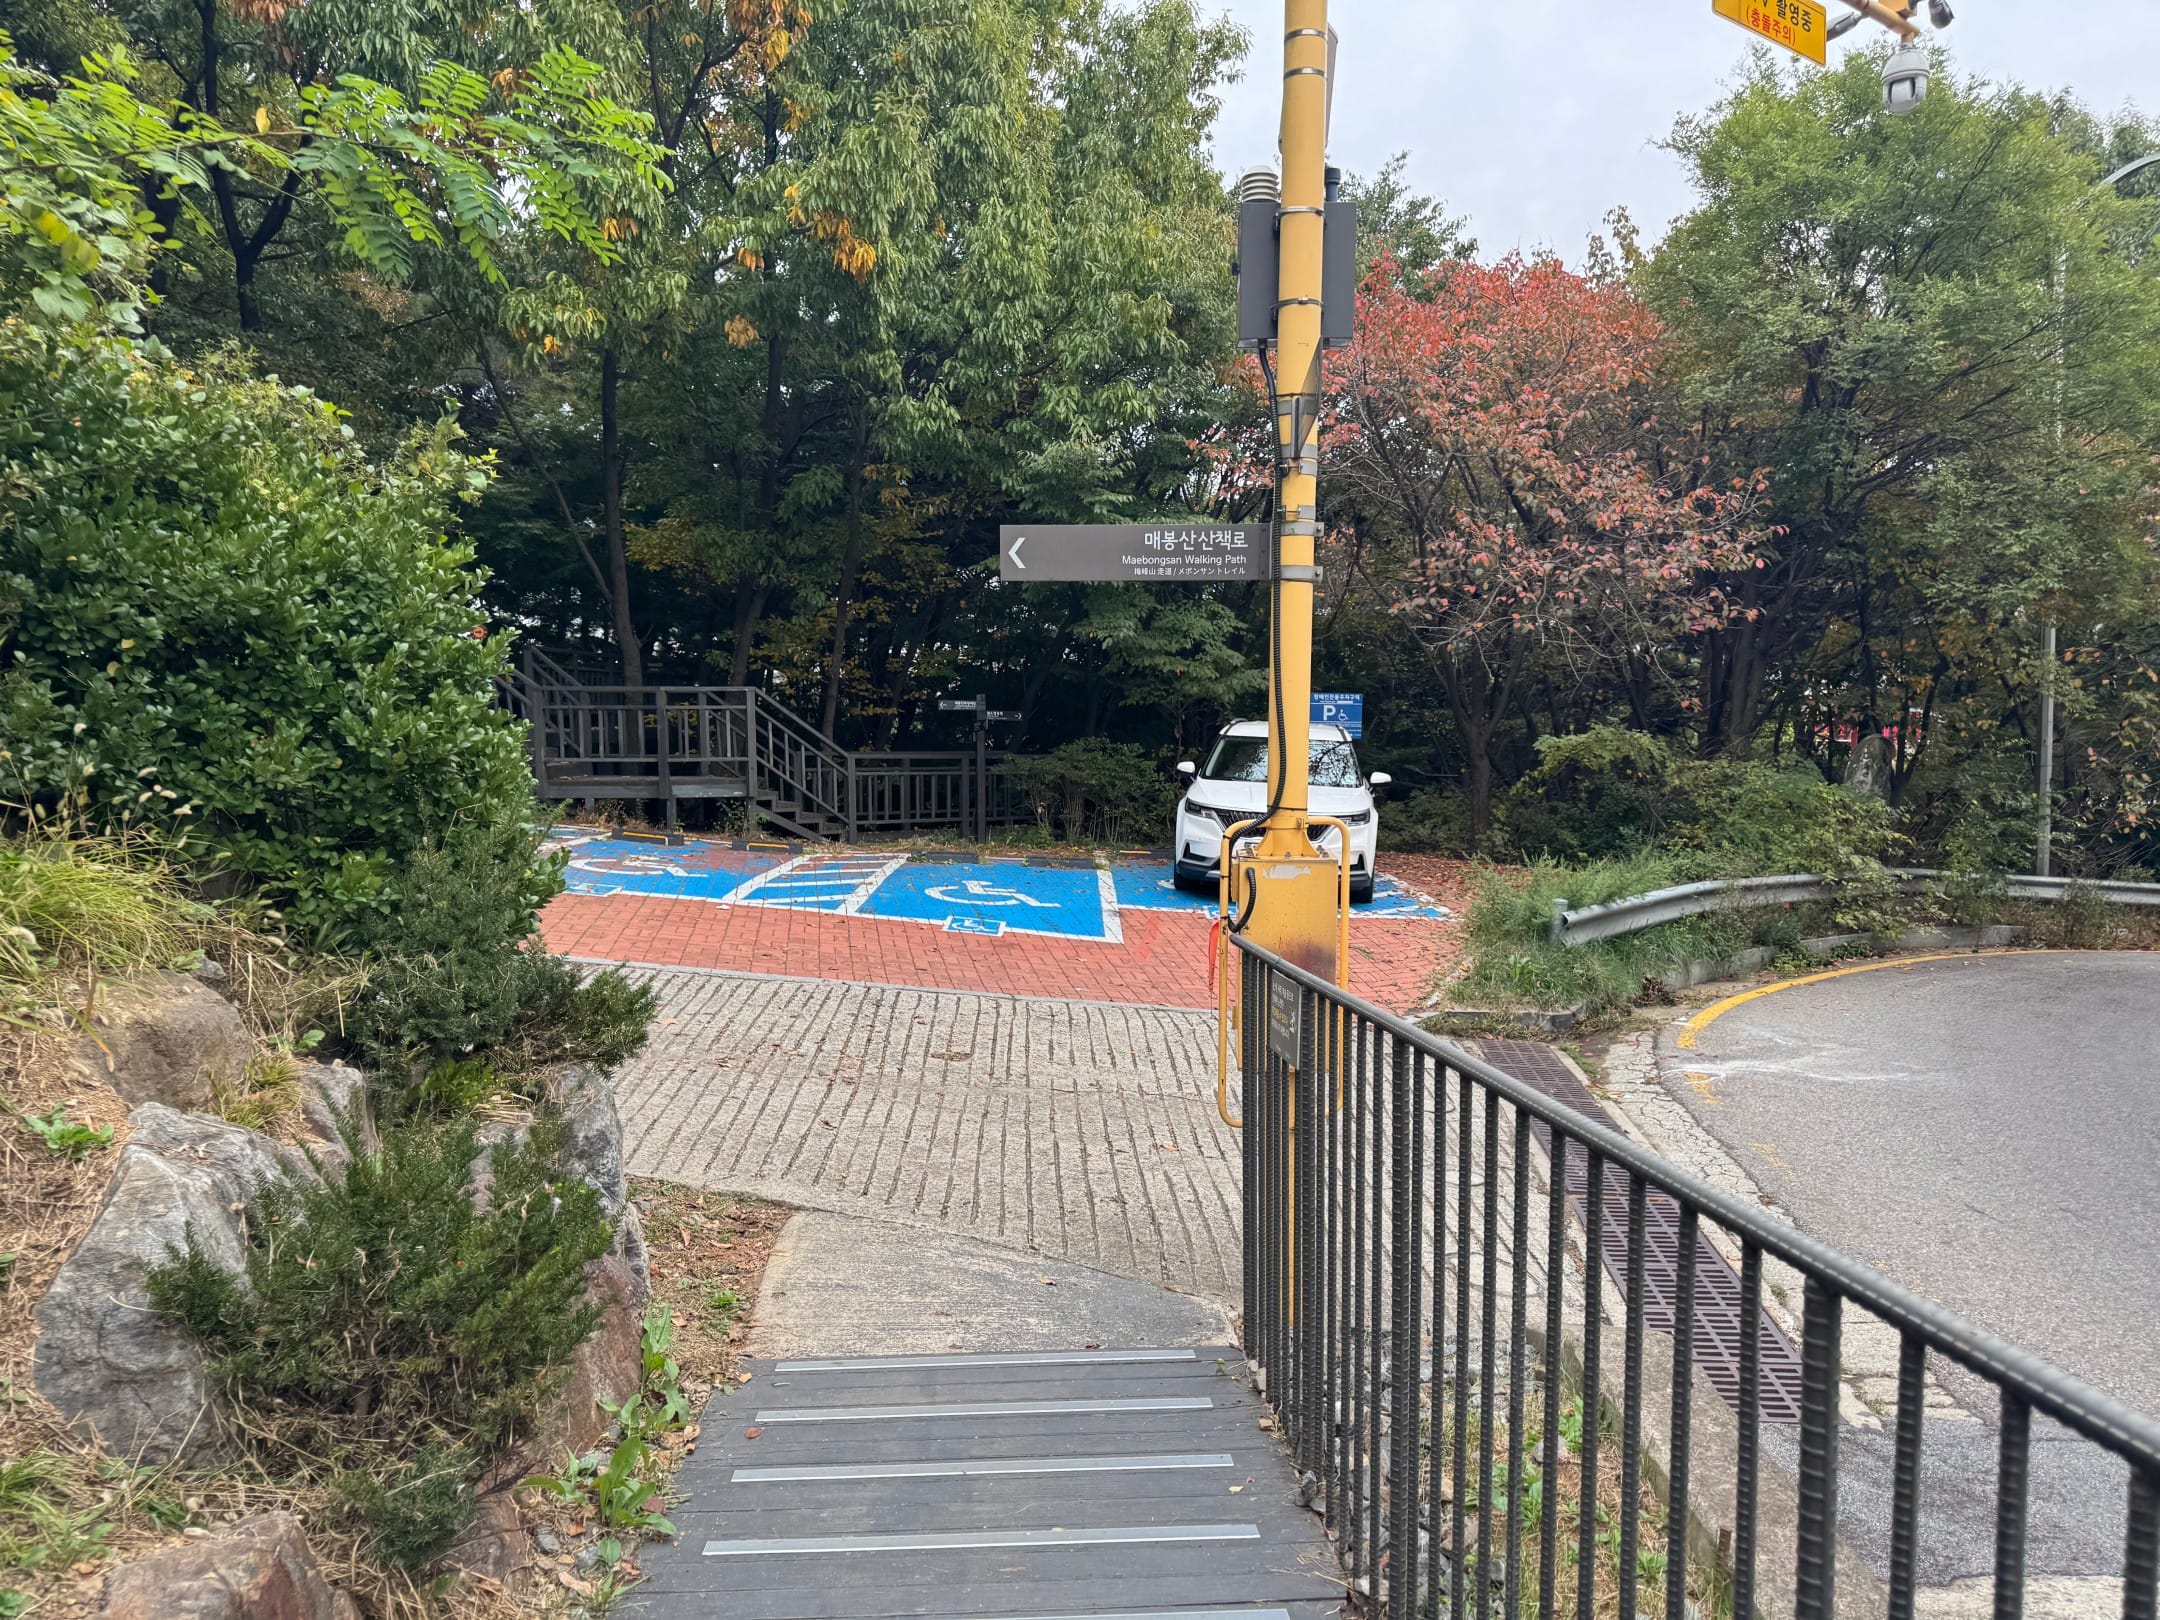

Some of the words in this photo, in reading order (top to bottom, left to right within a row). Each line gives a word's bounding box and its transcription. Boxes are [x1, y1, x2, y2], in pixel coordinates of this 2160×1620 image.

[1746, 6, 1796, 46] (충돌주의)
[1122, 555, 1182, 566] Maebongsan
[1184, 555, 1222, 566] Walking
[1225, 555, 1247, 564] Path
[1323, 705, 1336, 721] P
